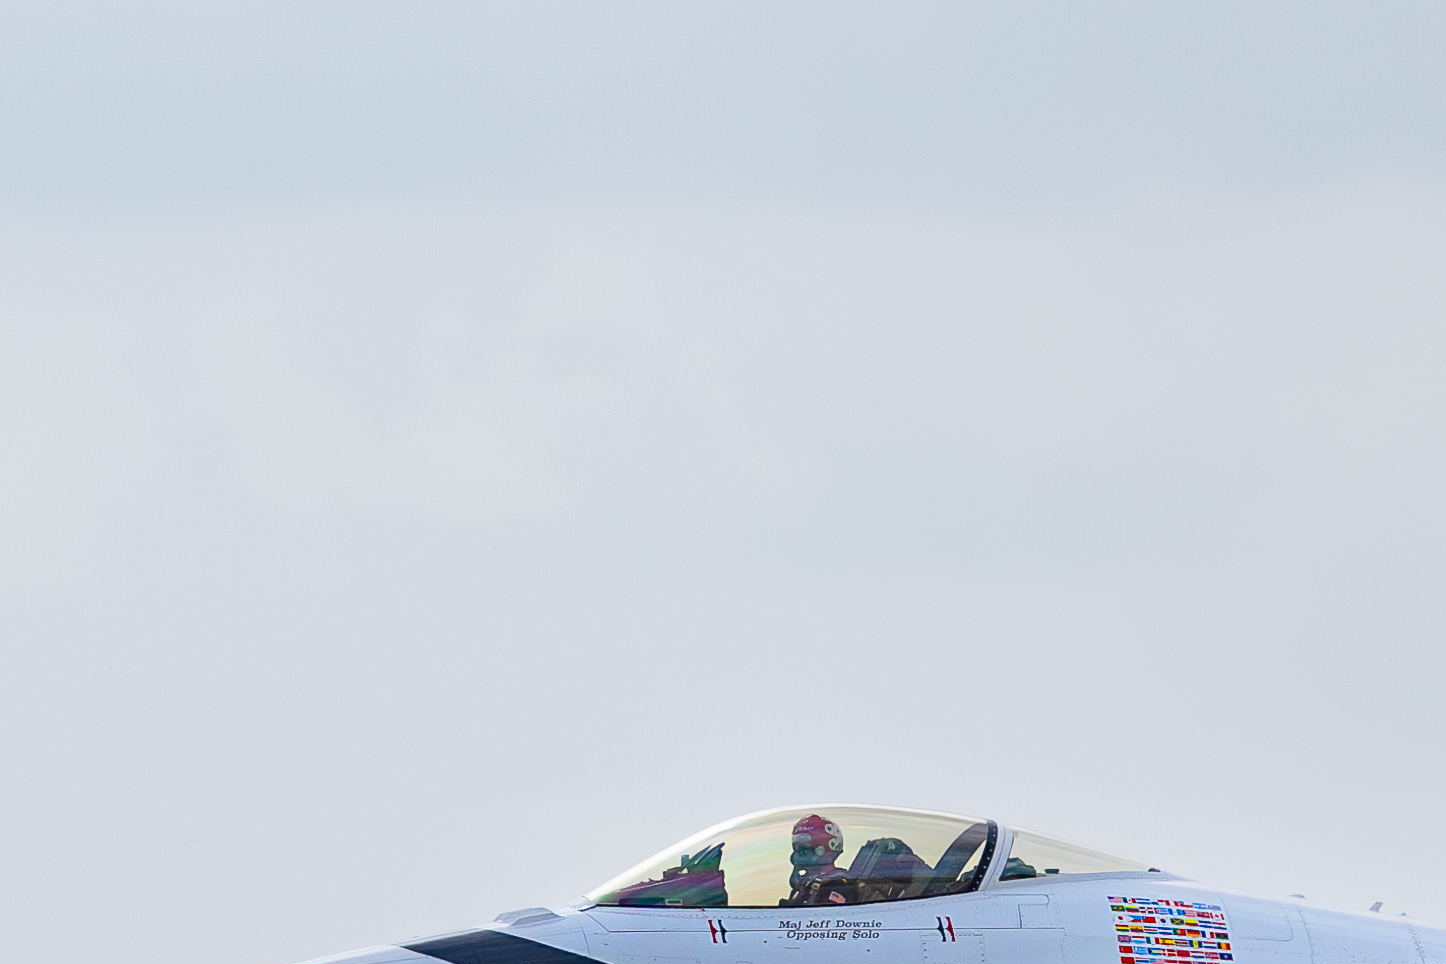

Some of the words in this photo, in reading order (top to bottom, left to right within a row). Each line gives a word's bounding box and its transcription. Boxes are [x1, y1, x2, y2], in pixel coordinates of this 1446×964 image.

[779, 920, 801, 930] Maj
[806, 919, 831, 928] Jeff
[836, 919, 882, 928] Downie
[787, 930, 847, 940] Opposing
[852, 930, 880, 938] Solo
